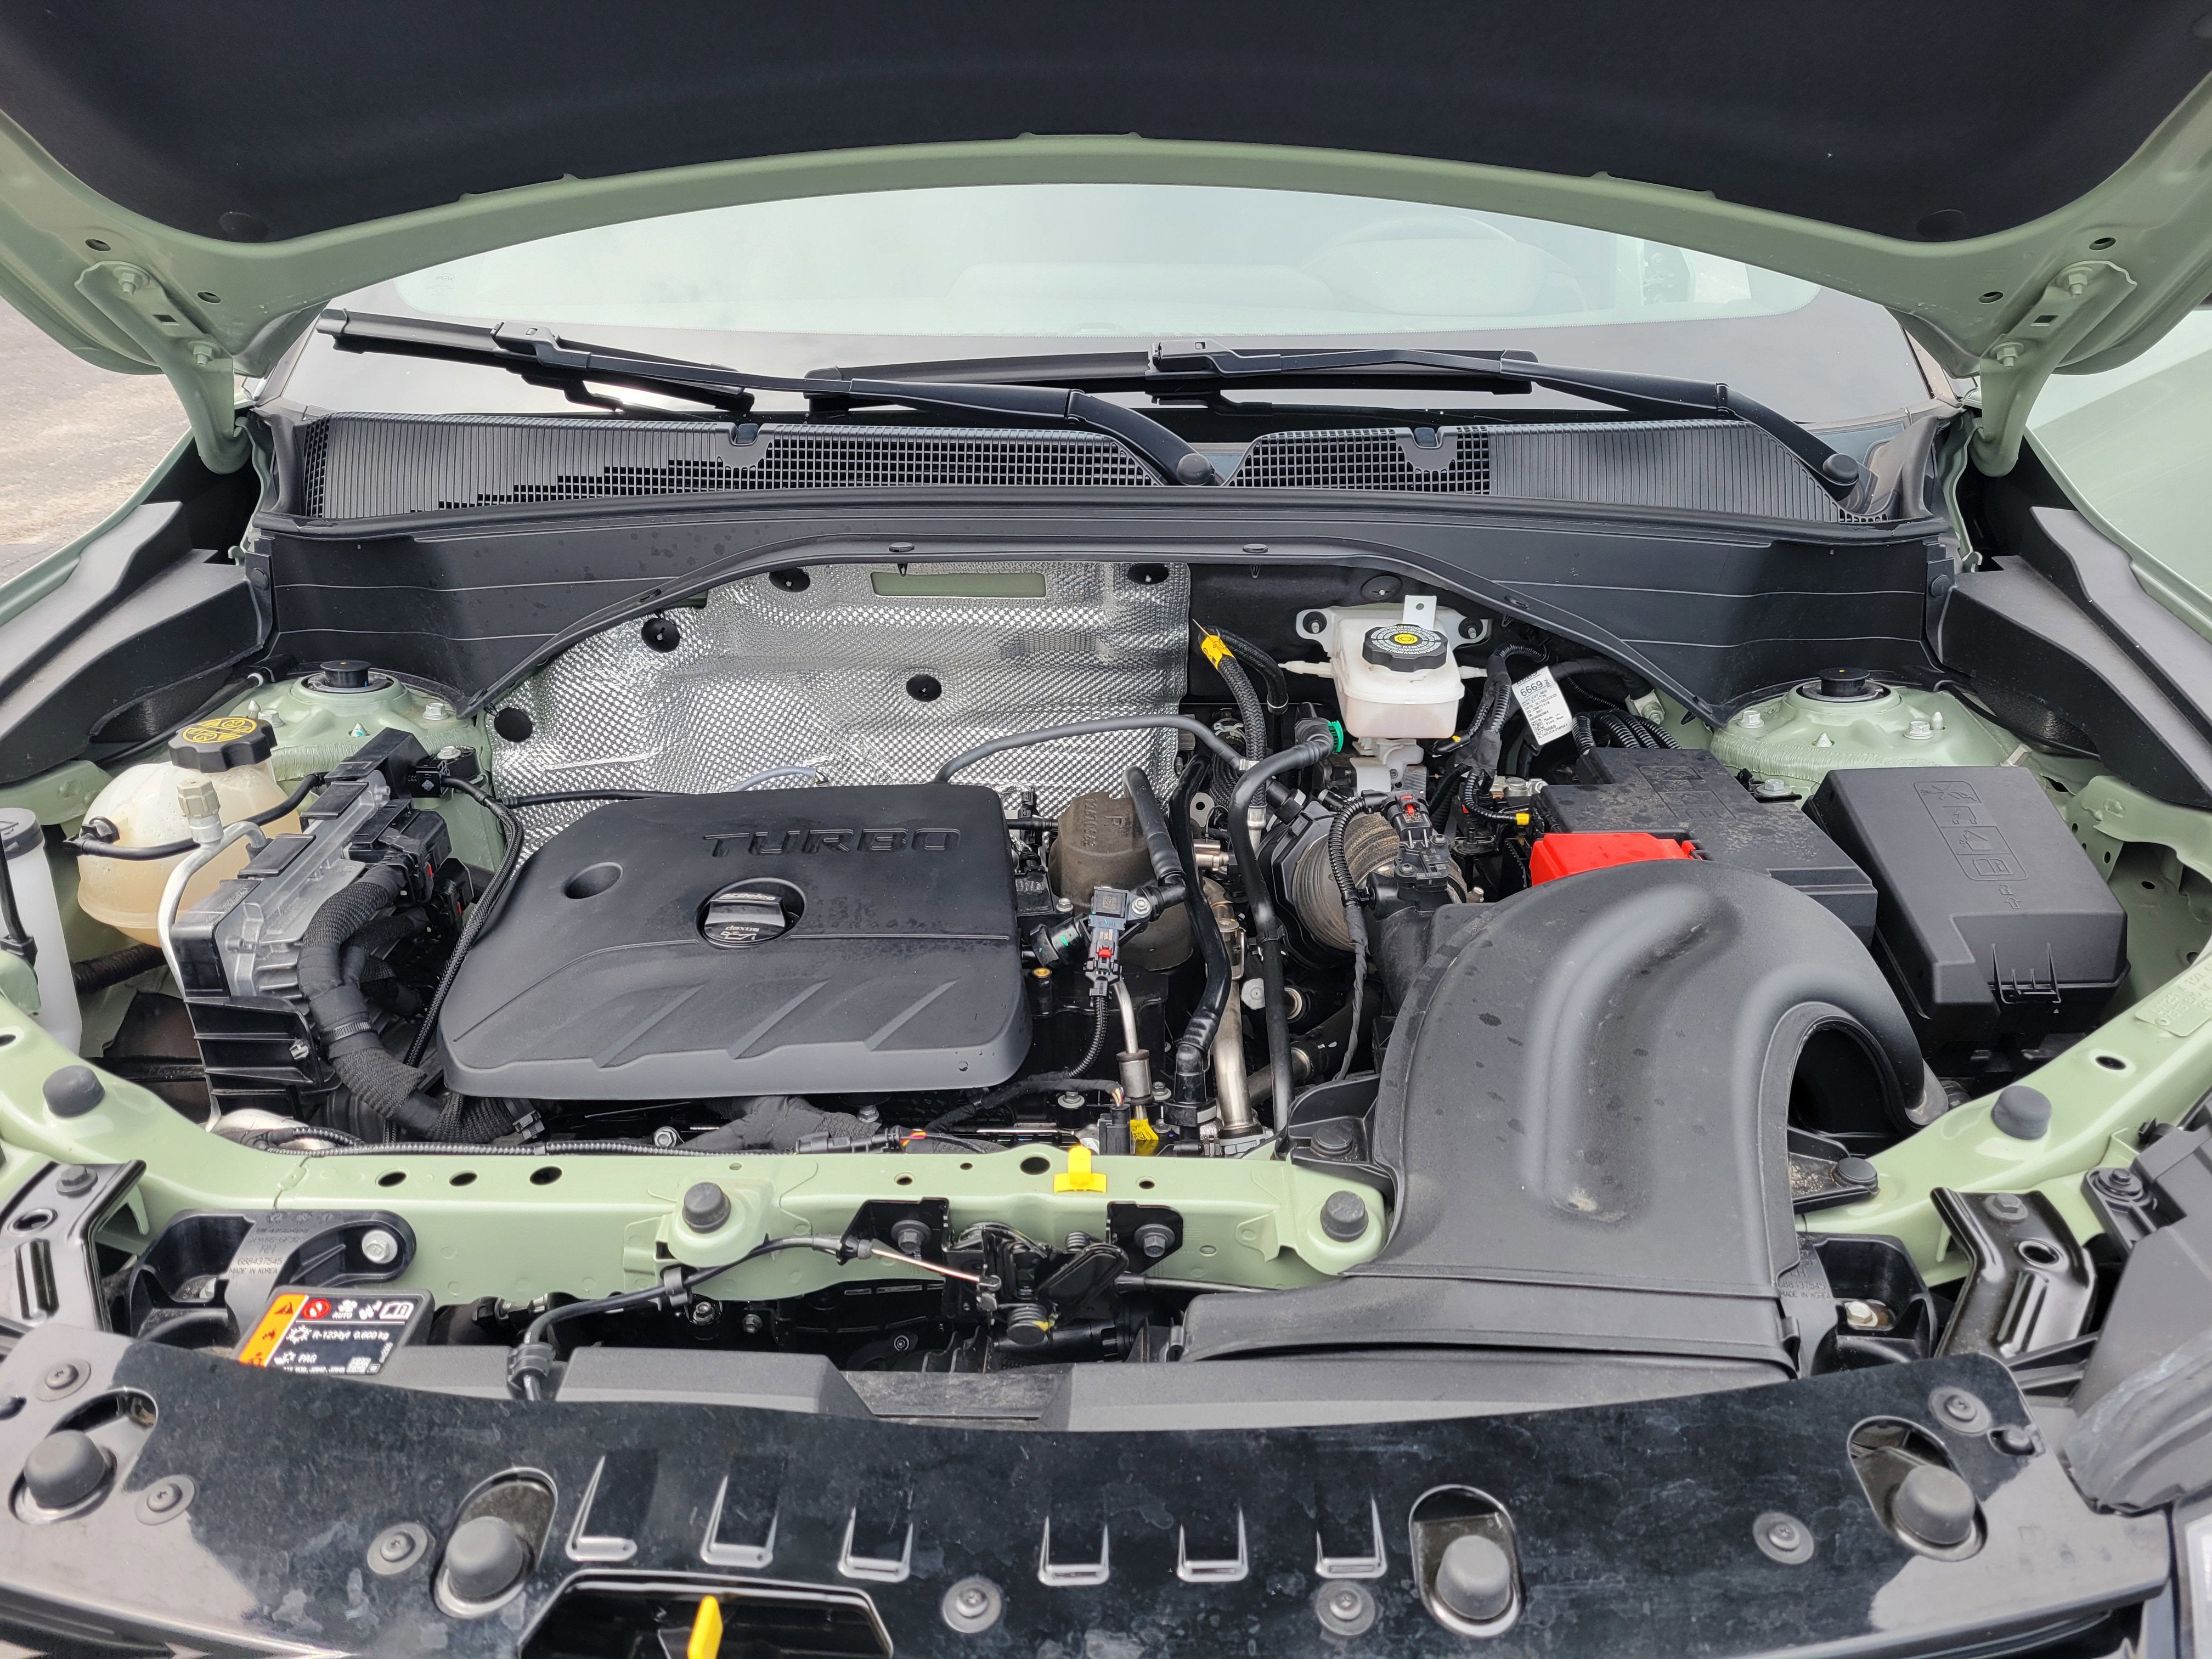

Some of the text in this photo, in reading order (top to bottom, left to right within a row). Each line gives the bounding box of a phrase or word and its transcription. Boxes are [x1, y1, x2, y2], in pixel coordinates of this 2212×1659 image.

[1520, 680, 1543, 697] 6669
[704, 828, 961, 857] TURBO
[259, 1245, 276, 1254] RH
[353, 1330, 377, 1340] 0.600
[377, 1330, 390, 1341] kg
[297, 1353, 318, 1363] PAG
